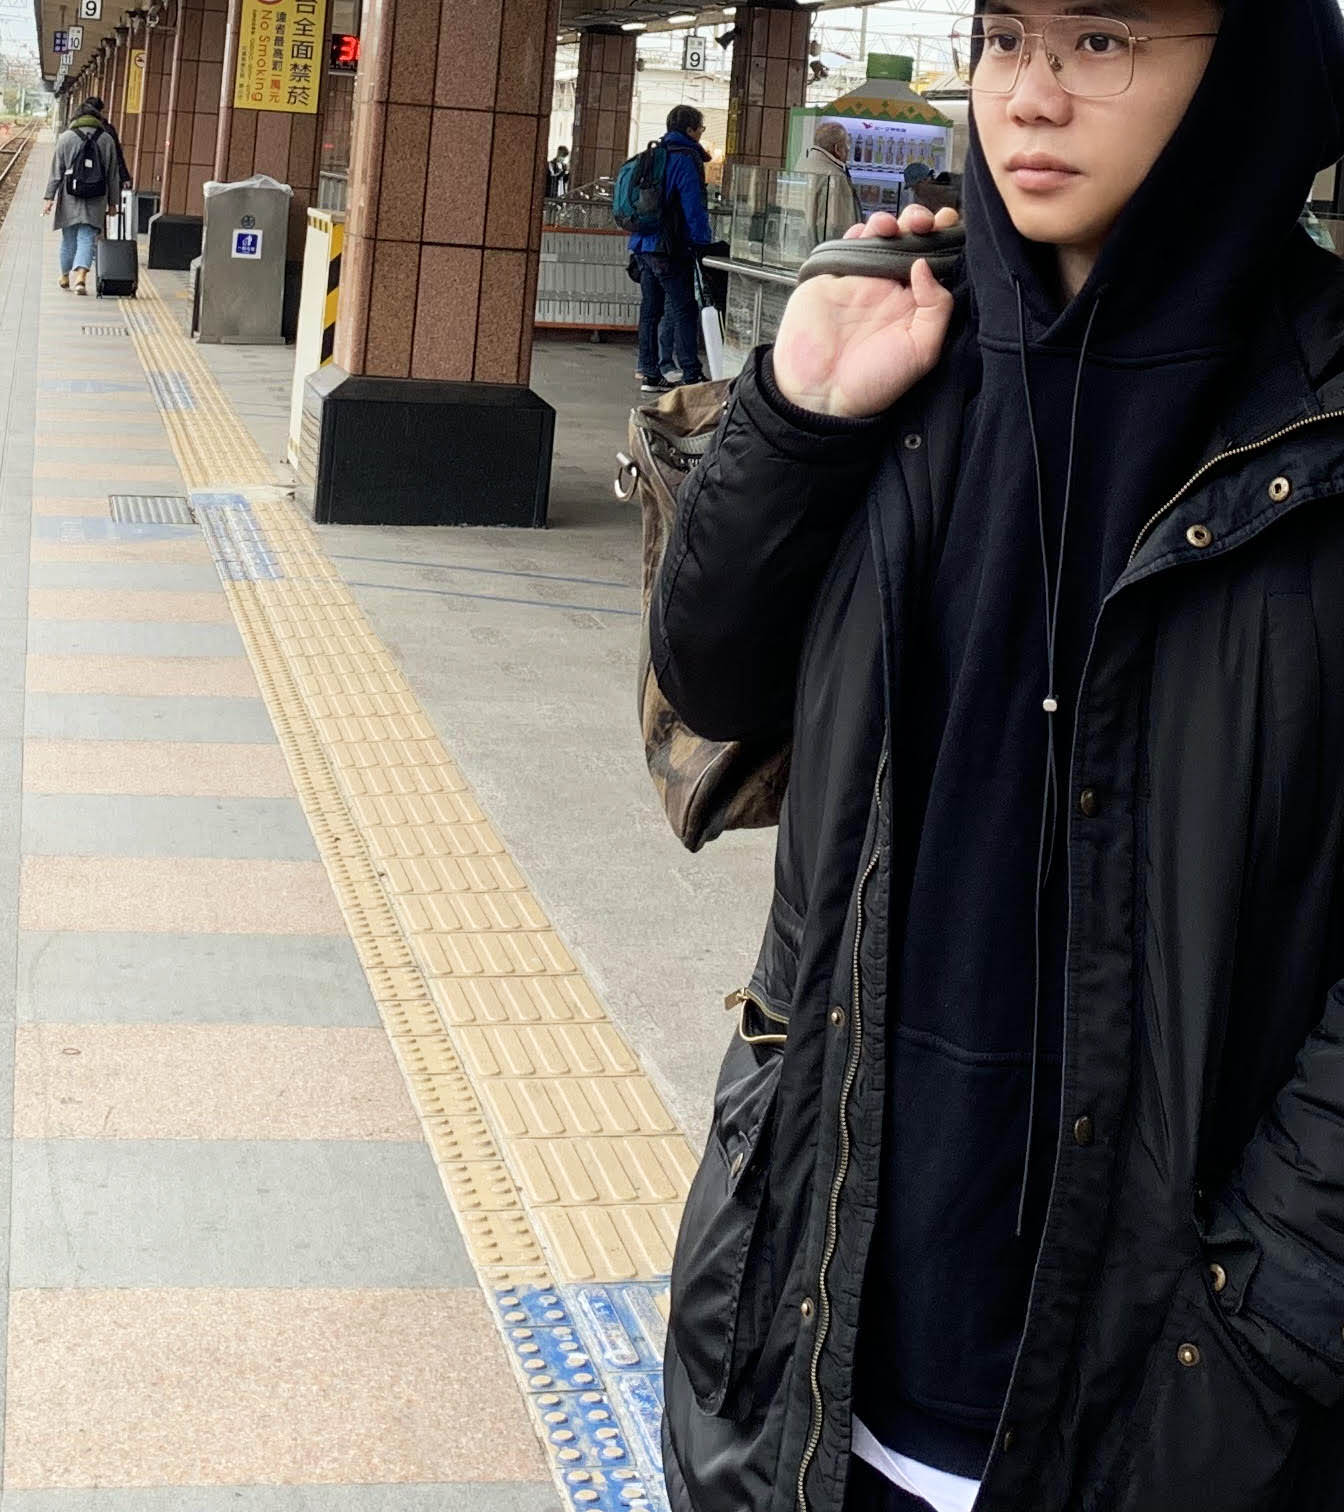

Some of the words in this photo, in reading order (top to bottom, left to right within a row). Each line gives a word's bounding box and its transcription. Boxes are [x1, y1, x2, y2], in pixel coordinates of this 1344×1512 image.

[85, 0, 97, 17] 9
[260, 9, 273, 31] No
[251, 35, 270, 102] Smoking
[690, 51, 701, 68] 9
